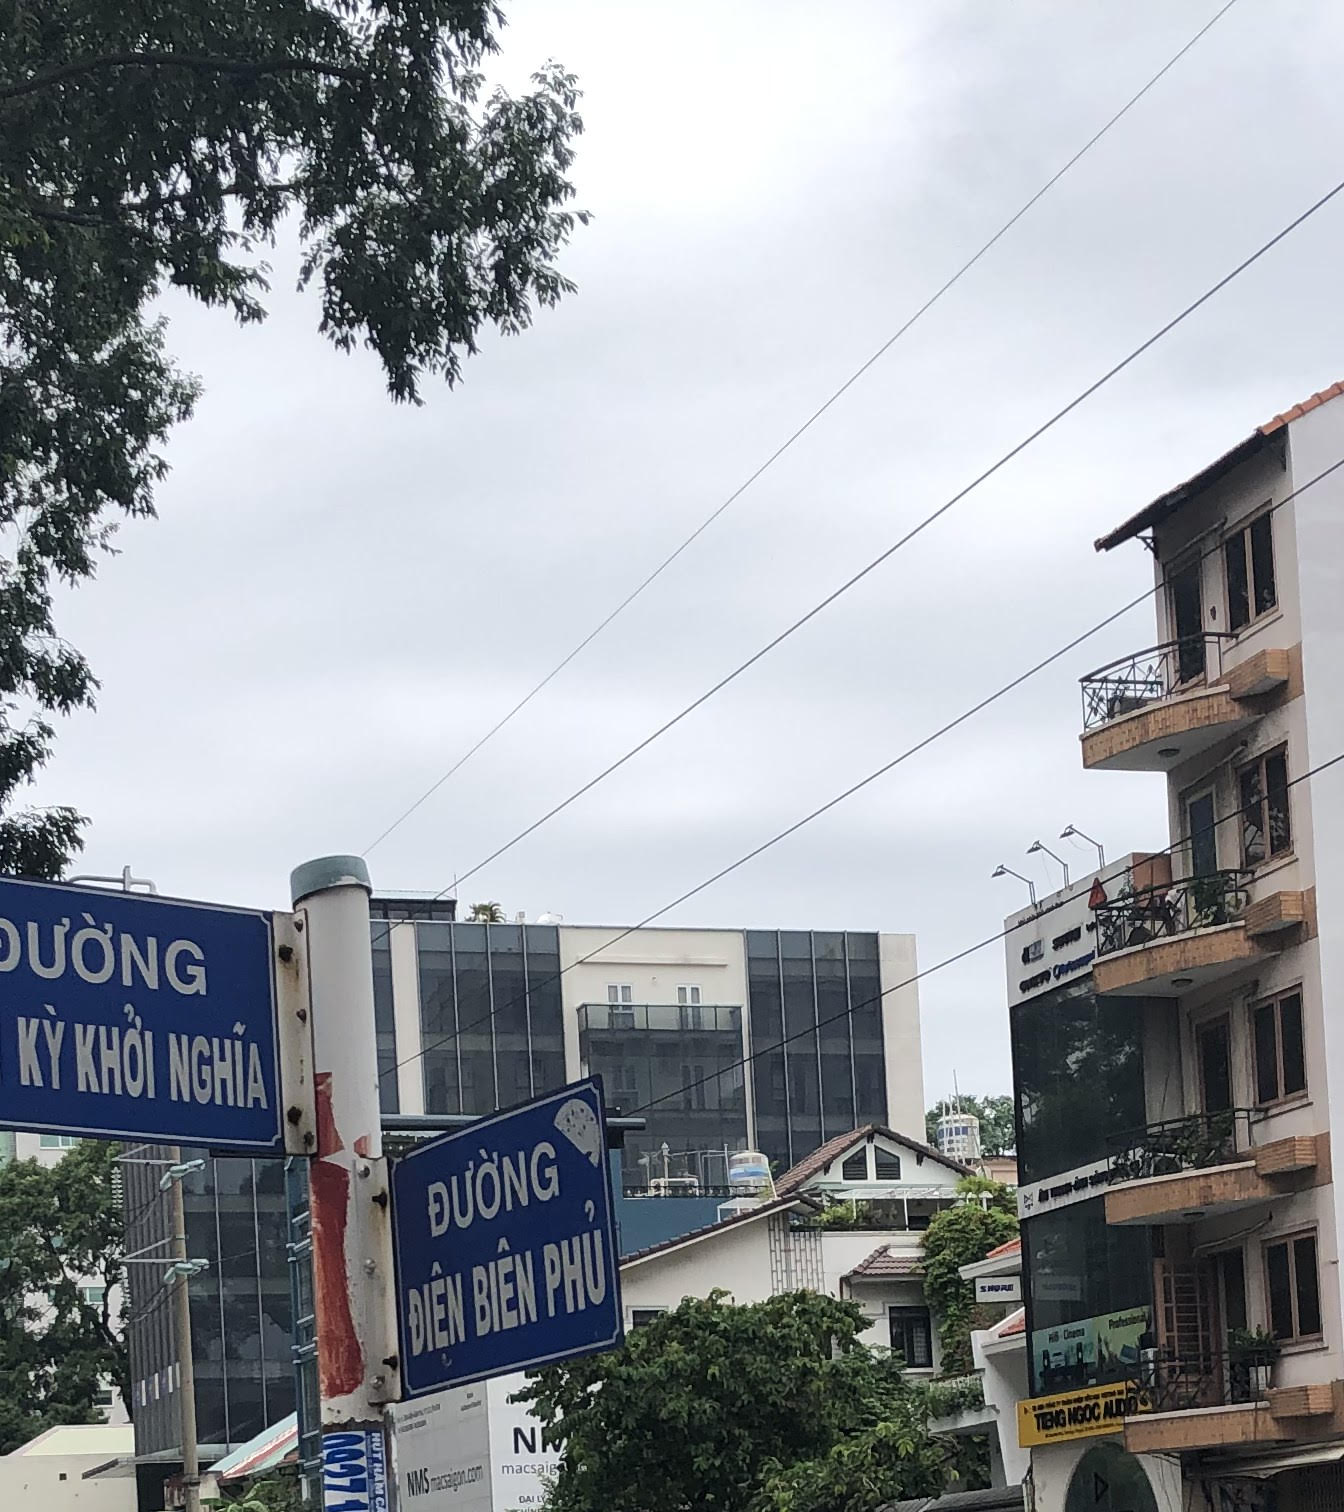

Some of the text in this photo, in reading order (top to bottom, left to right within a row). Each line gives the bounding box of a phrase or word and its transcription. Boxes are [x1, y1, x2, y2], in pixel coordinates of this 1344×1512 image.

[17, 1003, 66, 1090] KỲ
[74, 1003, 157, 1099] KHỞI
[168, 1021, 270, 1110] NGHĨA
[427, 1140, 561, 1238] ĐƯỜNG
[472, 1236, 538, 1337] BIÊN
[543, 1199, 607, 1318] PHỦ
[407, 1465, 483, 1497] NMS macsaigon.com
